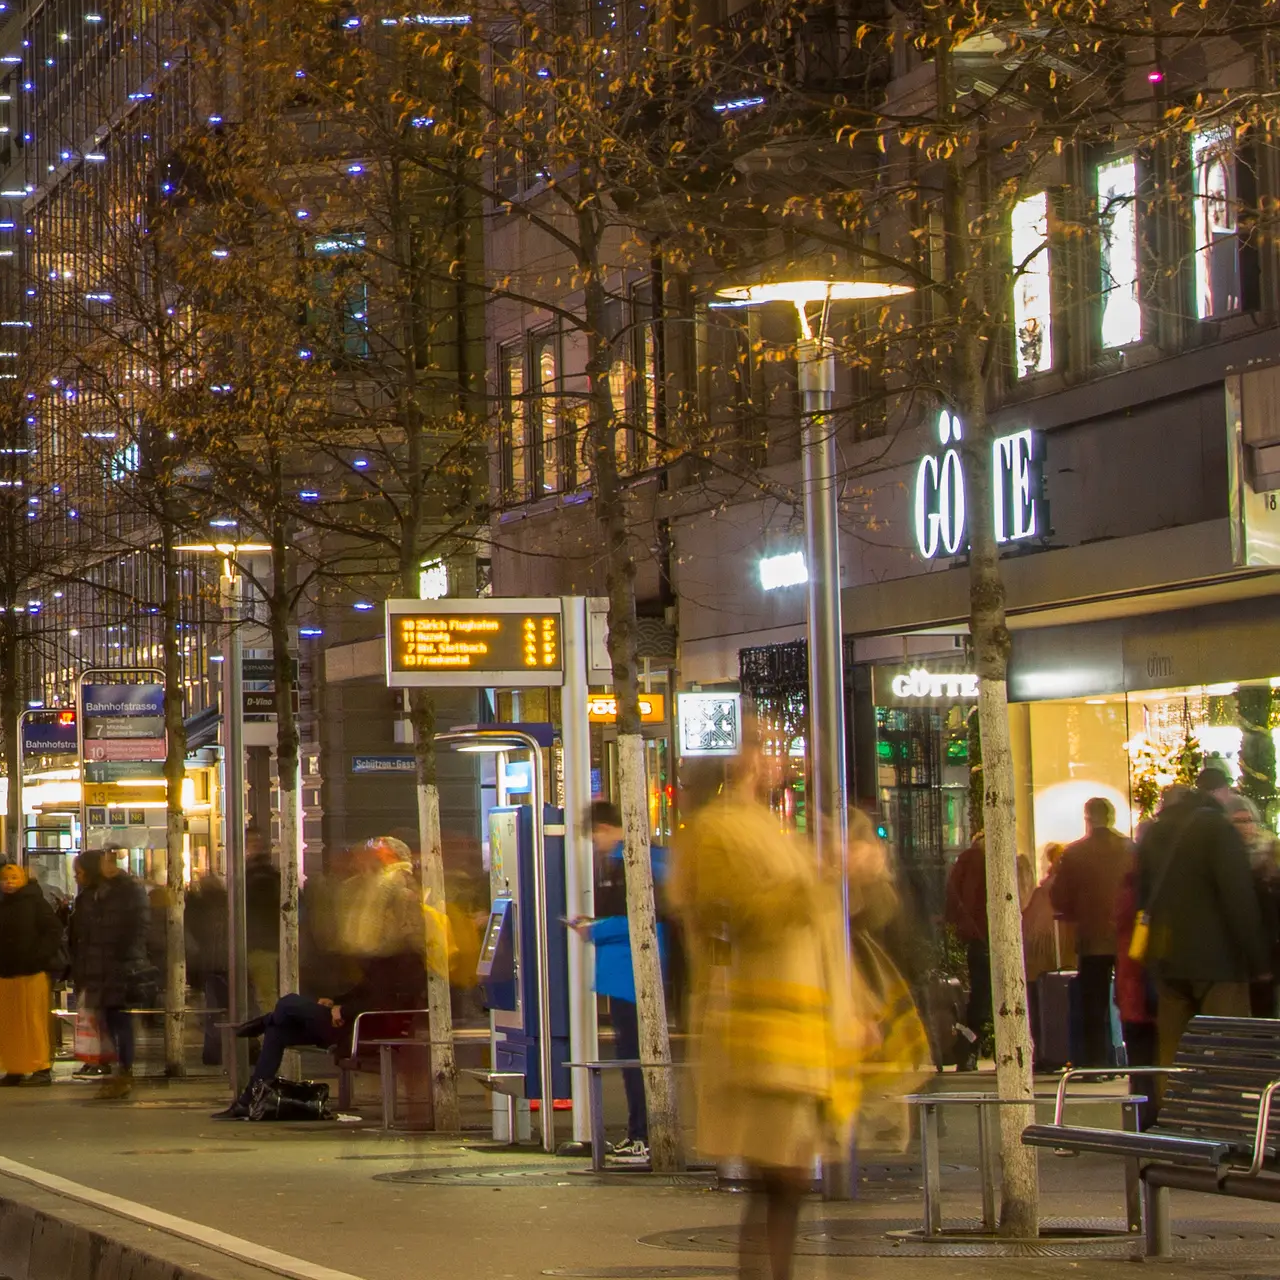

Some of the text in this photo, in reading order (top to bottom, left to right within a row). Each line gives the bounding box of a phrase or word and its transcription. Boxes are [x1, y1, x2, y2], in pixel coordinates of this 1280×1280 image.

[914, 409, 1039, 559] GÖTE
[407, 643, 415, 653] 7
[891, 667, 980, 698] GÖTTE
[85, 702, 157, 712] Bahnhofstrasse
[246, 698, 273, 706] D-Vino
[95, 725, 104, 736] 7
[25, 740, 78, 749] Bahnhofstra
[90, 746, 105, 759] 10
[92, 769, 105, 781] 11
[92, 792, 106, 803] 13
